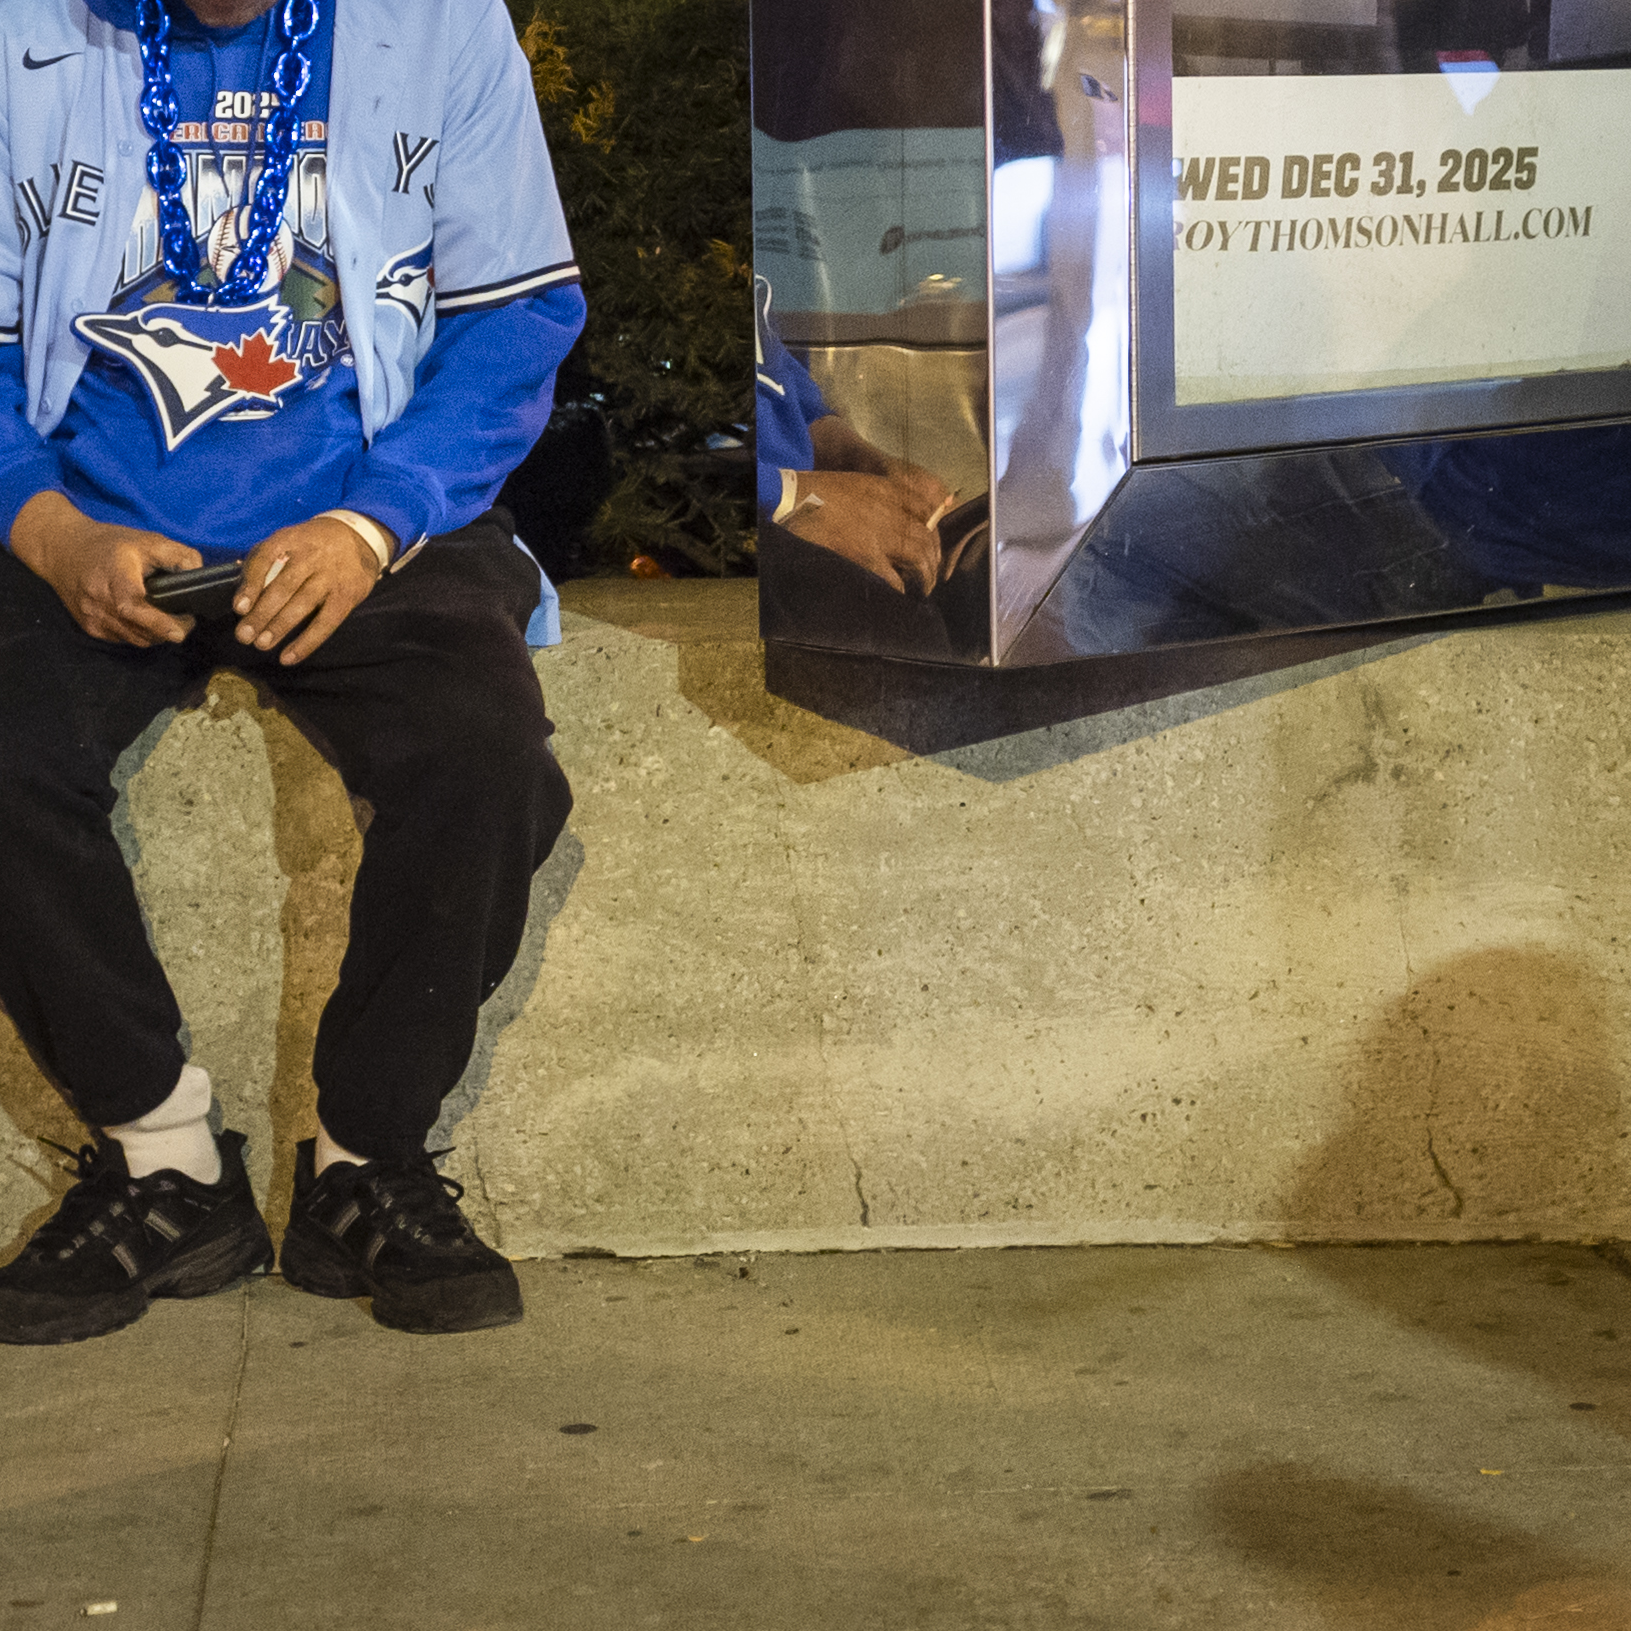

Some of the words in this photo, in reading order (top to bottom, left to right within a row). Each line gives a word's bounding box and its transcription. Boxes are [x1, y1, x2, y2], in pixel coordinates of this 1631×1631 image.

[1173, 156, 1271, 201] WED
[1281, 152, 1362, 199] DEC
[1371, 151, 1427, 198] 31,
[1437, 147, 1539, 193] 2025
